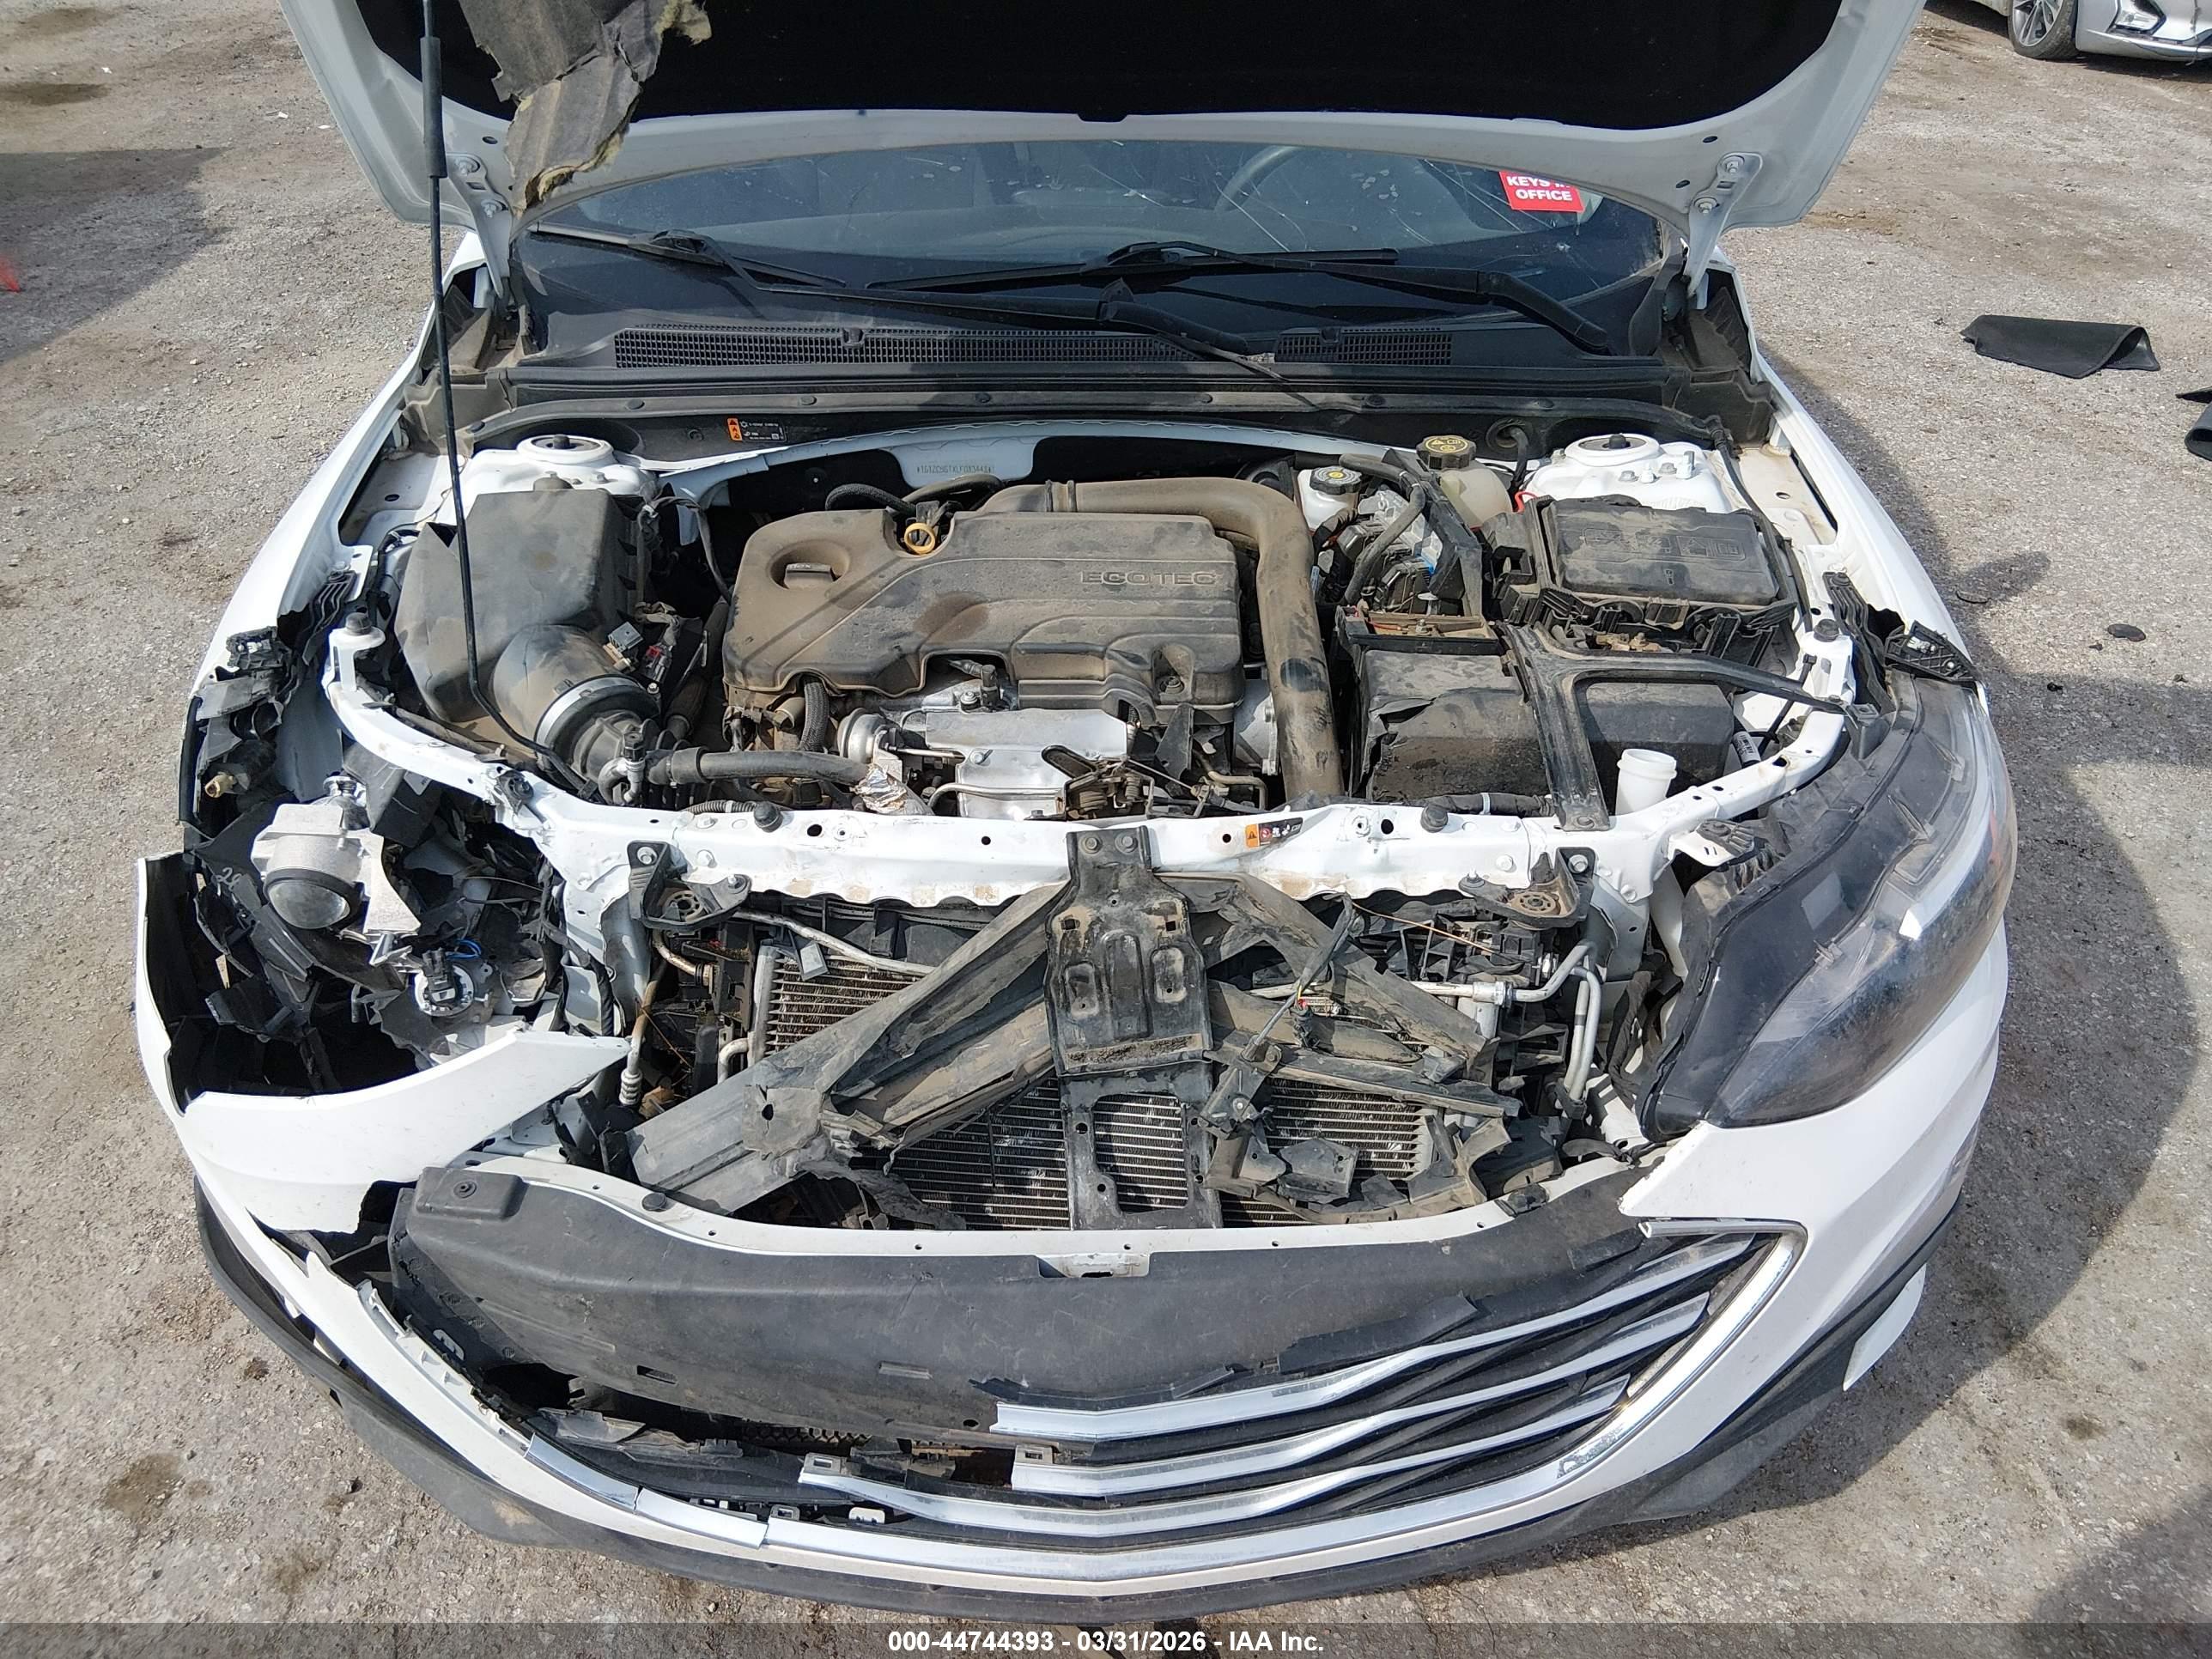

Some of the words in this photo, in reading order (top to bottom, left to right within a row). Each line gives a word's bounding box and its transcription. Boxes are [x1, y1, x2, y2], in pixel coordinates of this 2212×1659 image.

[1506, 176, 1551, 187] KEYS
[1515, 189, 1573, 201] OFFICE
[1080, 570, 1218, 586] ECOTEC
